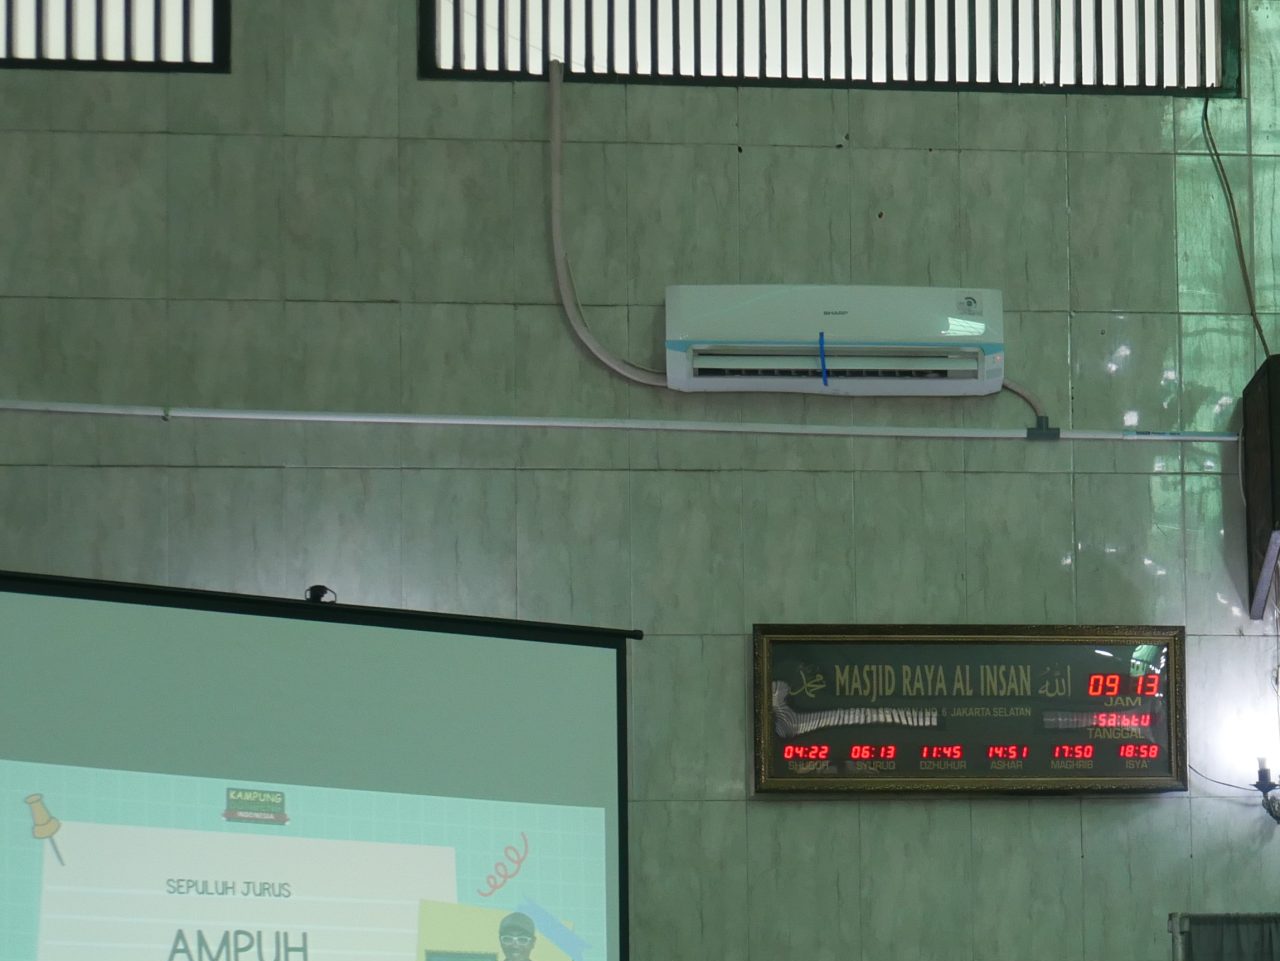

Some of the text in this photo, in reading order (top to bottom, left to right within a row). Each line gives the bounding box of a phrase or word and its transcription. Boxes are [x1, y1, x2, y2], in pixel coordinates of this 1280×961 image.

[834, 664, 1032, 702] MASJID RAYA AL INSAN
[1088, 673, 1160, 697] 09 13
[1104, 696, 1142, 707] JAM
[950, 706, 991, 717] JAKARTA
[992, 706, 1032, 717] SELATAN
[1087, 727, 1145, 739] TANGGAL
[783, 744, 1160, 759] 04:22 06:13 11:45 14:51 17:50 18:58
[990, 760, 1023, 770] ASHAR
[1050, 760, 1094, 769] MAGHRIB
[229, 789, 282, 803] KAMPUNG
[165, 877, 292, 898] SEPULUH JURUS
